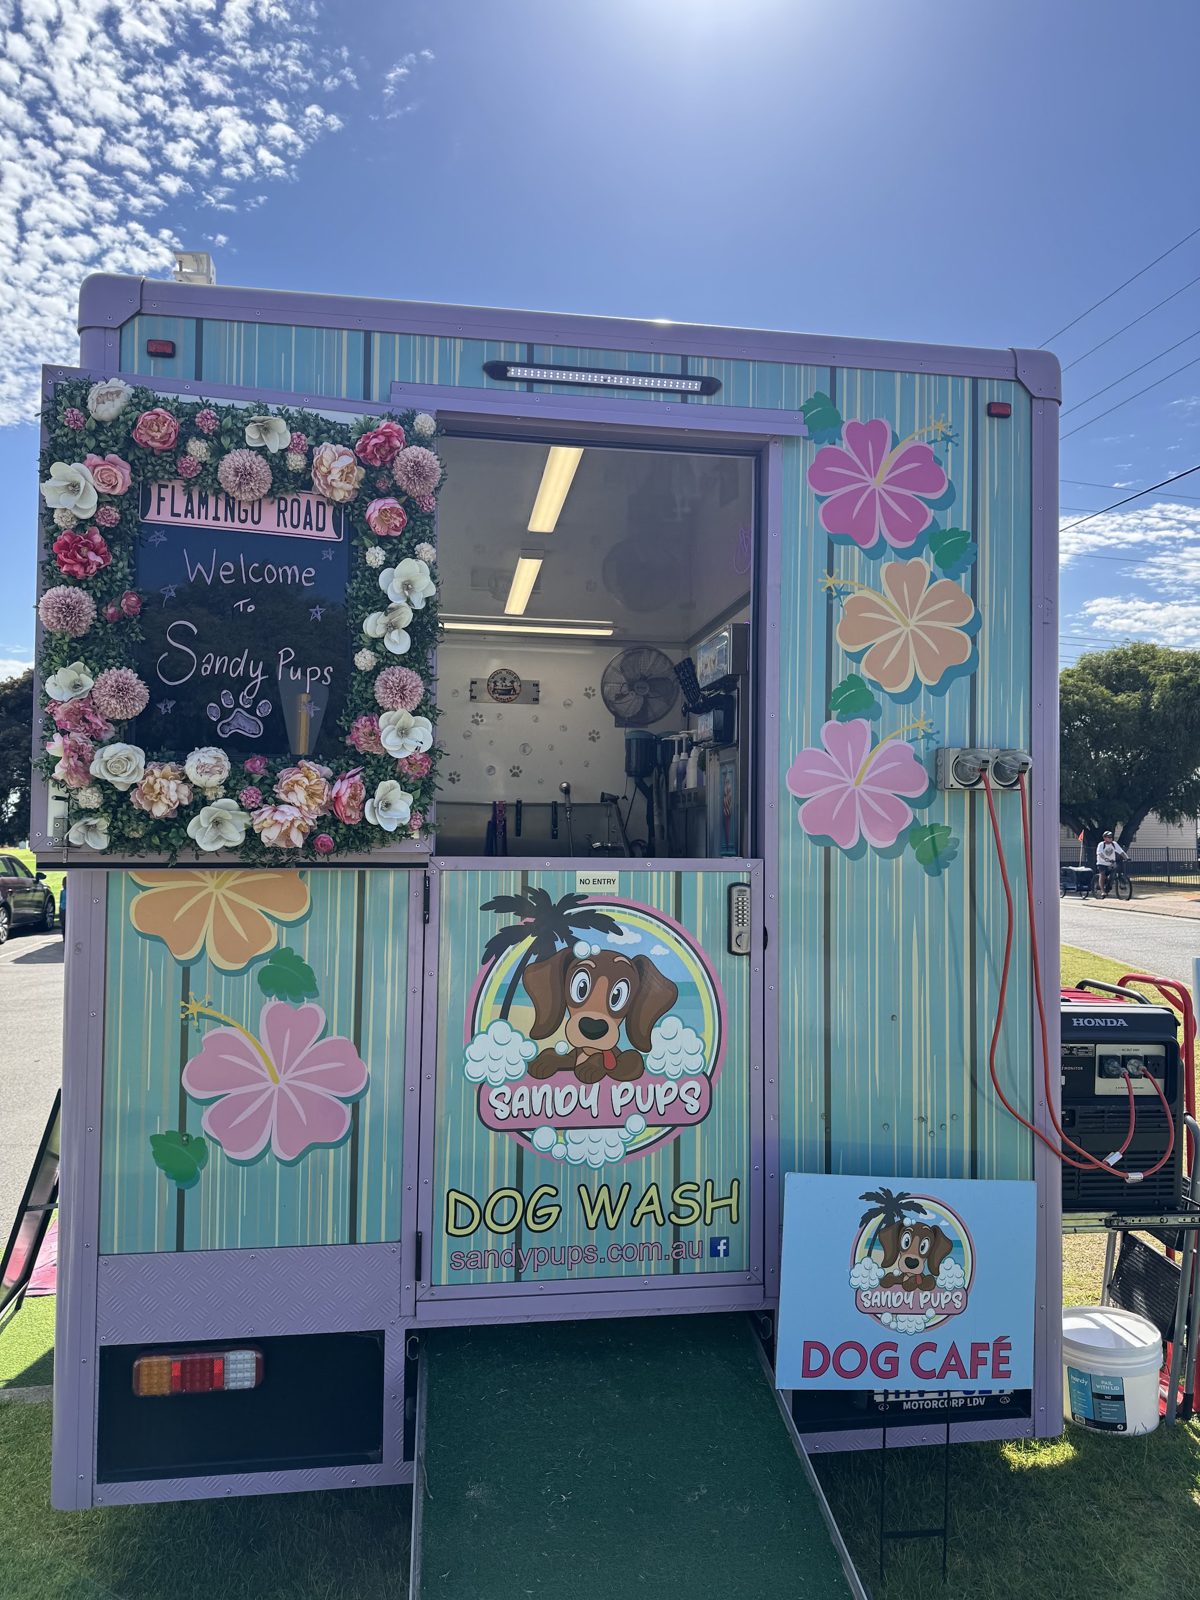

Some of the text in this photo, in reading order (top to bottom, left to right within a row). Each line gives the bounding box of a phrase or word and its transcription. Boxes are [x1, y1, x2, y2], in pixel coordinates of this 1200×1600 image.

[156, 484, 327, 532] FLAMINGO ROAD
[183, 548, 316, 587] Welcome
[233, 597, 256, 613] To
[156, 620, 334, 699] Sandy Pups
[592, 878, 617, 886] ENTRY
[1071, 1017, 1129, 1027] HONDA
[488, 1080, 702, 1120] SANDY PUPS
[446, 1177, 741, 1238] DOG WASH
[450, 1240, 704, 1273] sandypups.com.au
[860, 1290, 963, 1309] SANDY PUPS
[801, 1335, 1013, 1380] DOG CAFÉ
[966, 1396, 986, 1408] LDV
